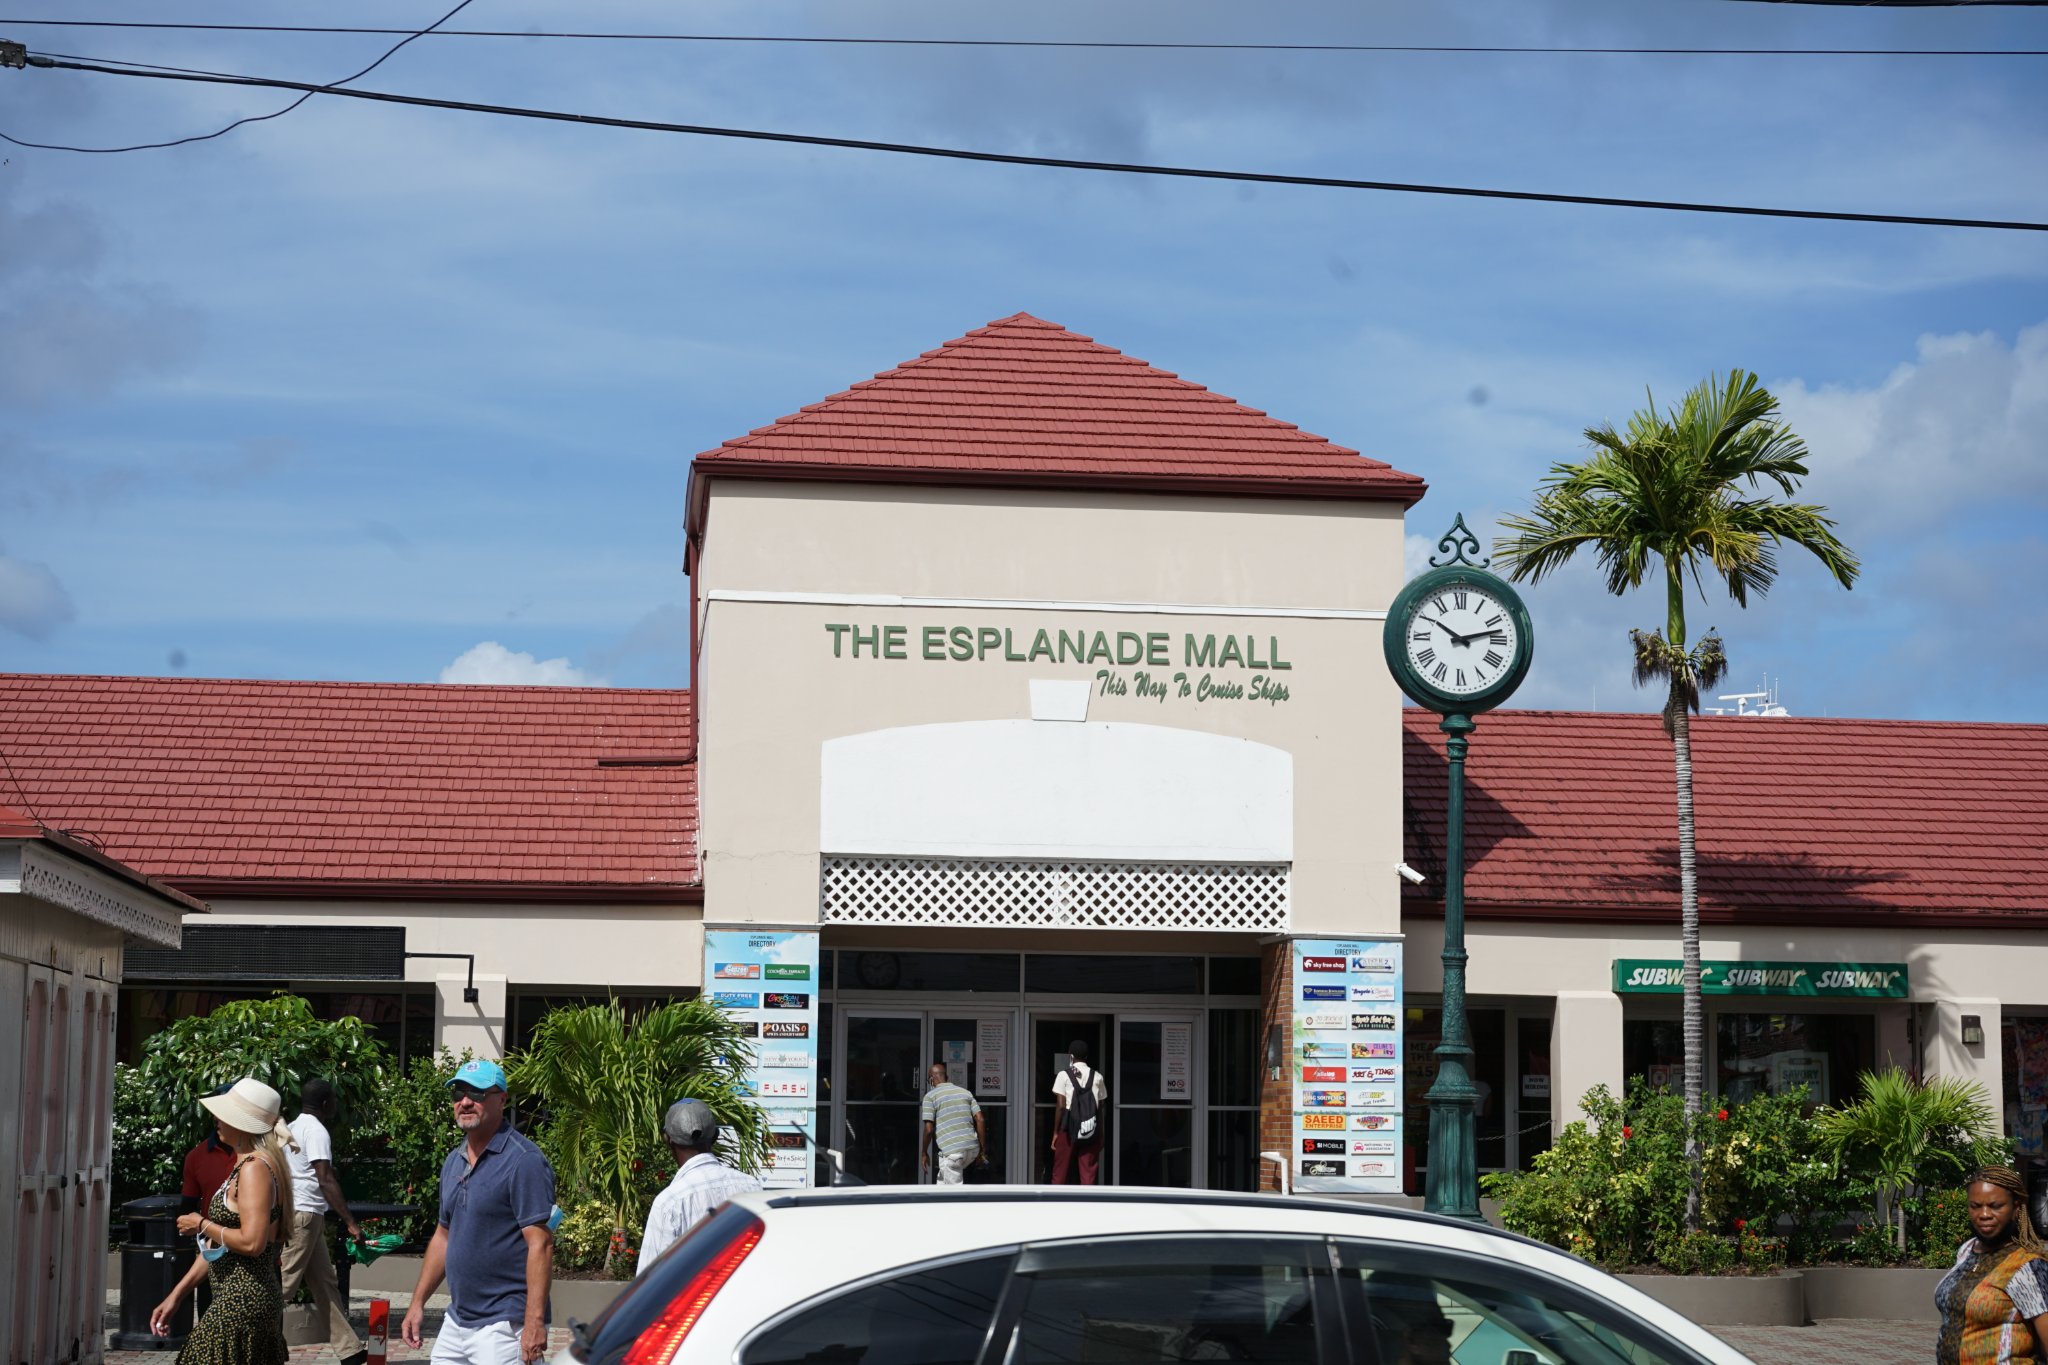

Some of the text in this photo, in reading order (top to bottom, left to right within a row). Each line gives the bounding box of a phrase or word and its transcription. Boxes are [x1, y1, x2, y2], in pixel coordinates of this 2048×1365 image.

[824, 624, 1292, 670] THE ESPLANADE MALL
[1096, 670, 1290, 706] This Way To Cruise Ships
[1627, 966, 1900, 988] SUBW SUBWAY SUBWAY
[772, 1024, 800, 1032] OASIS
[1783, 1070, 1818, 1080] SAVORY
[764, 1084, 806, 1093] FLASH
[1305, 1115, 1343, 1123] SAEED
